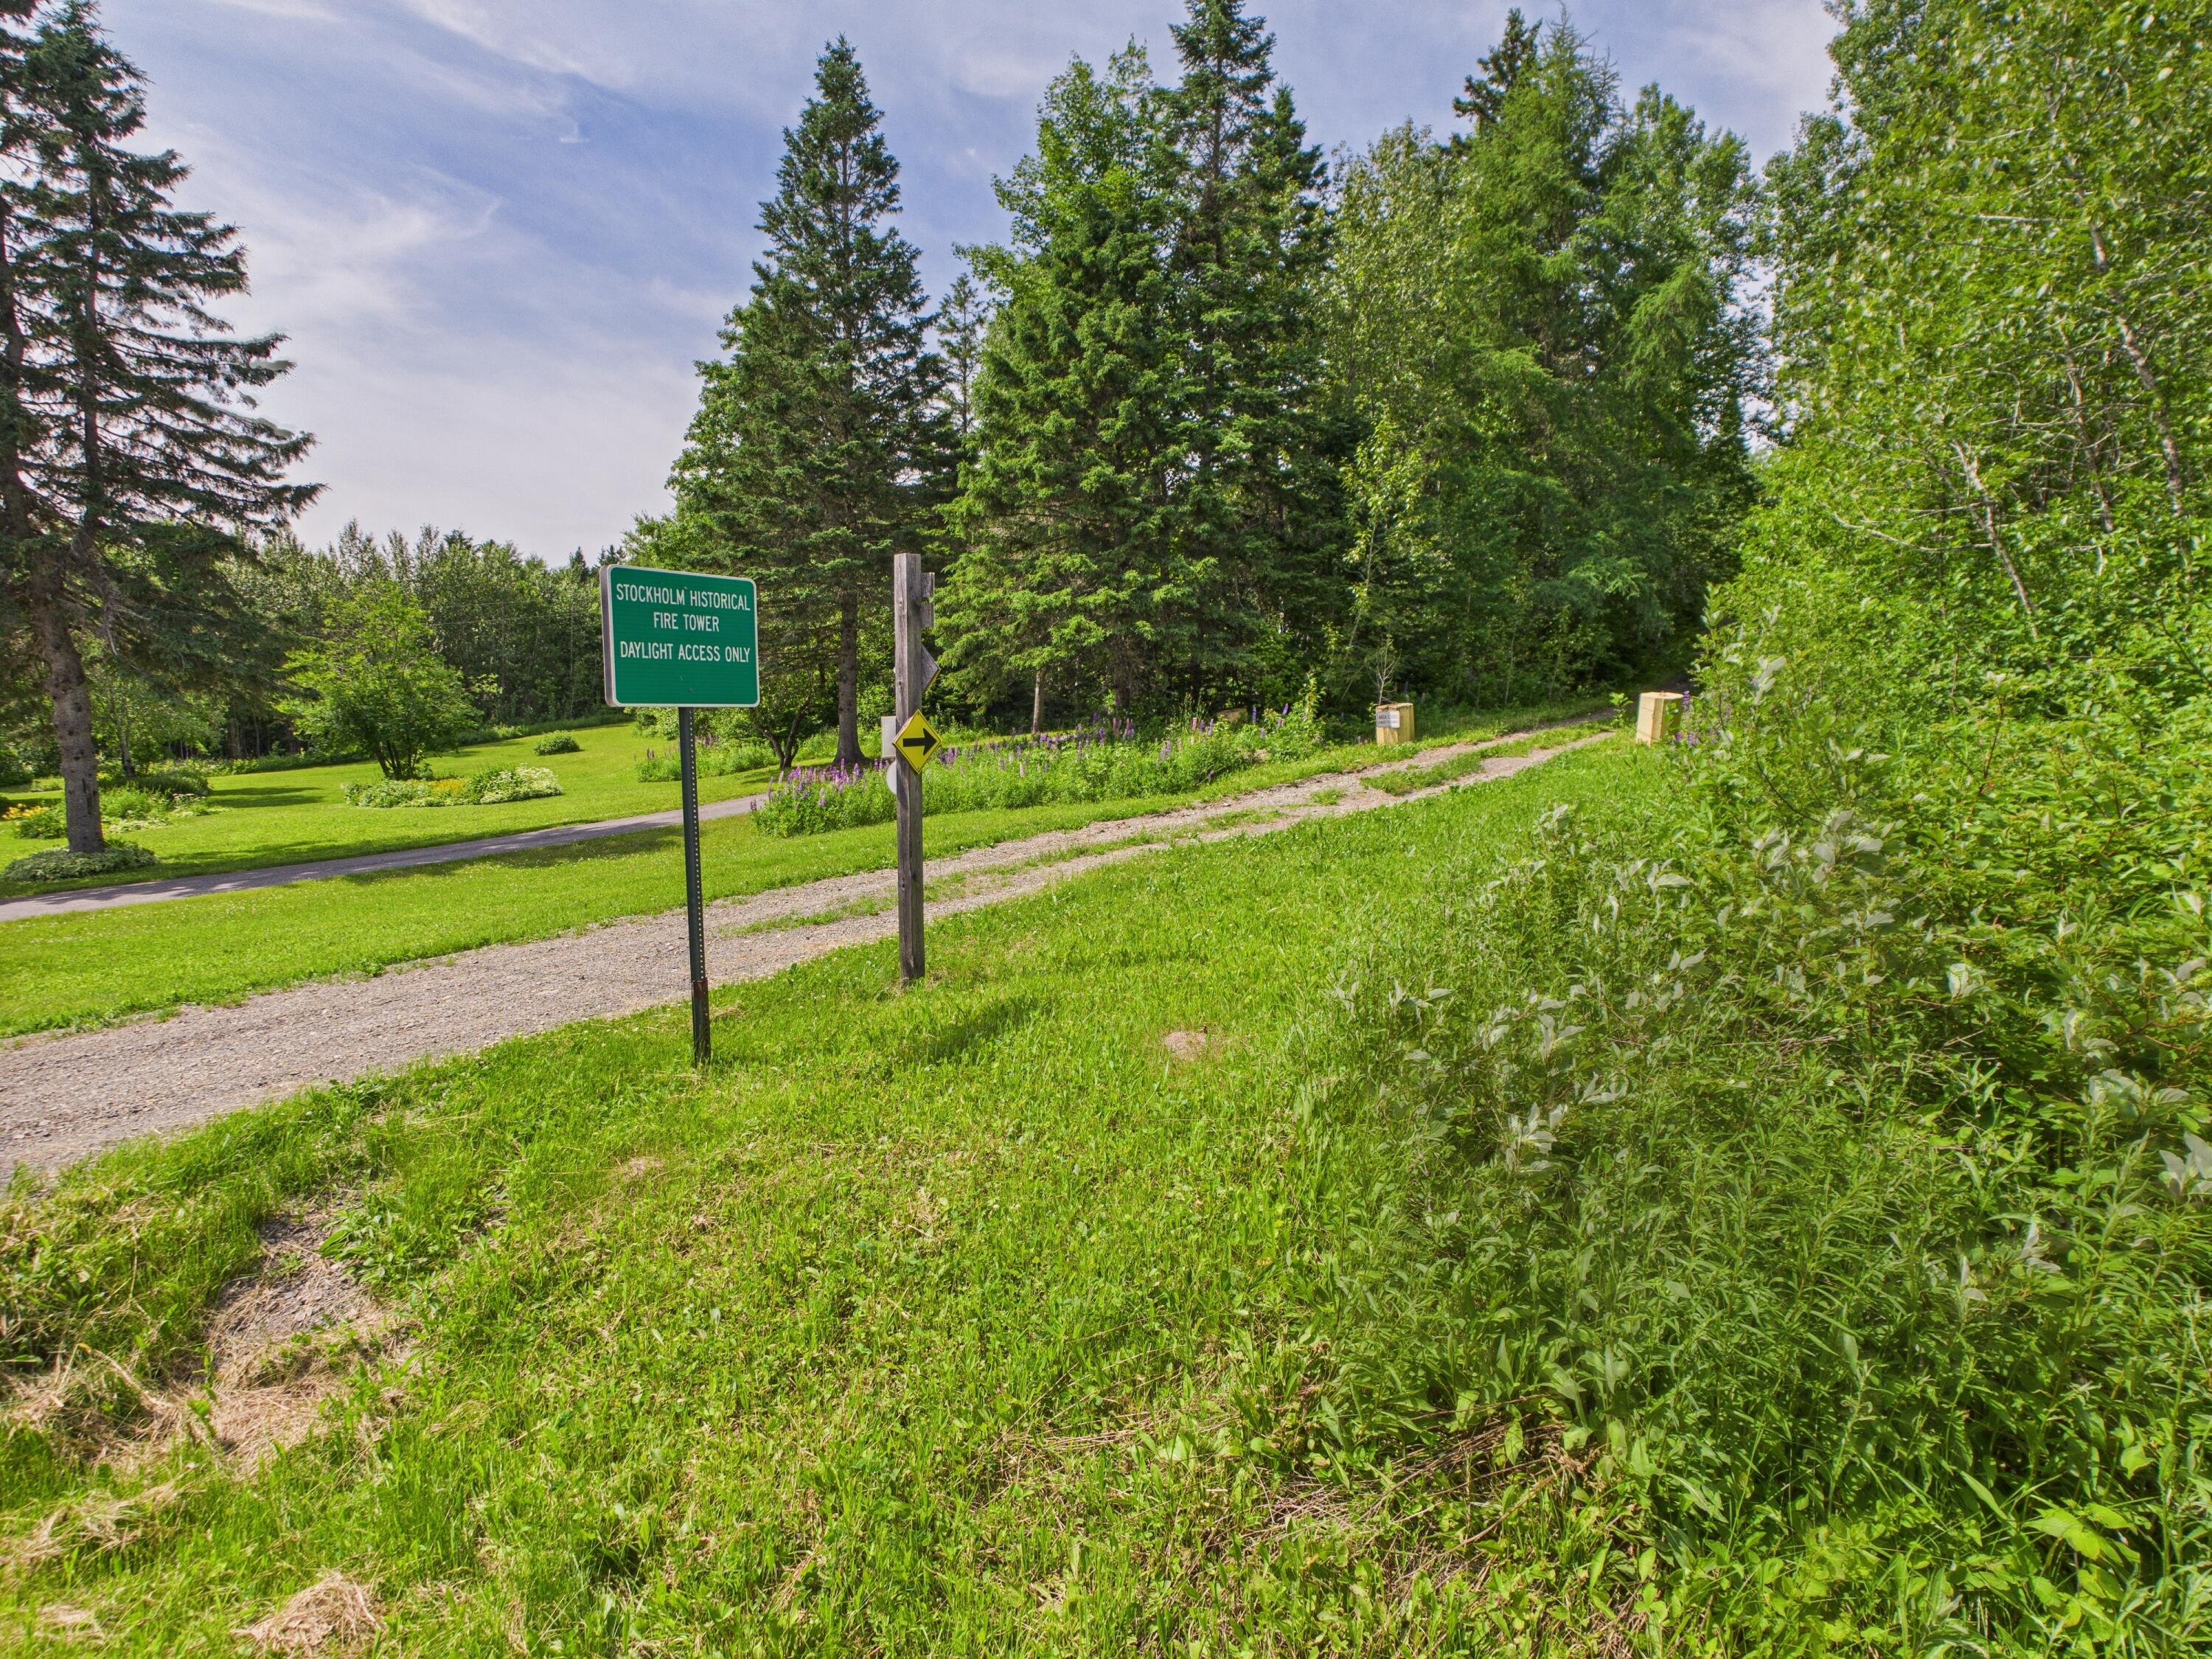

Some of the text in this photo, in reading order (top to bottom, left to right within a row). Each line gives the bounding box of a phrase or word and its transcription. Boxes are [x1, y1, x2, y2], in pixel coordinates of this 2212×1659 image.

[616, 583, 751, 611] STOCKHOLM HISTORICAL
[653, 612, 720, 632] FIRE TOWER
[620, 641, 750, 663] DAYLIGHT ACCESS ONLY
